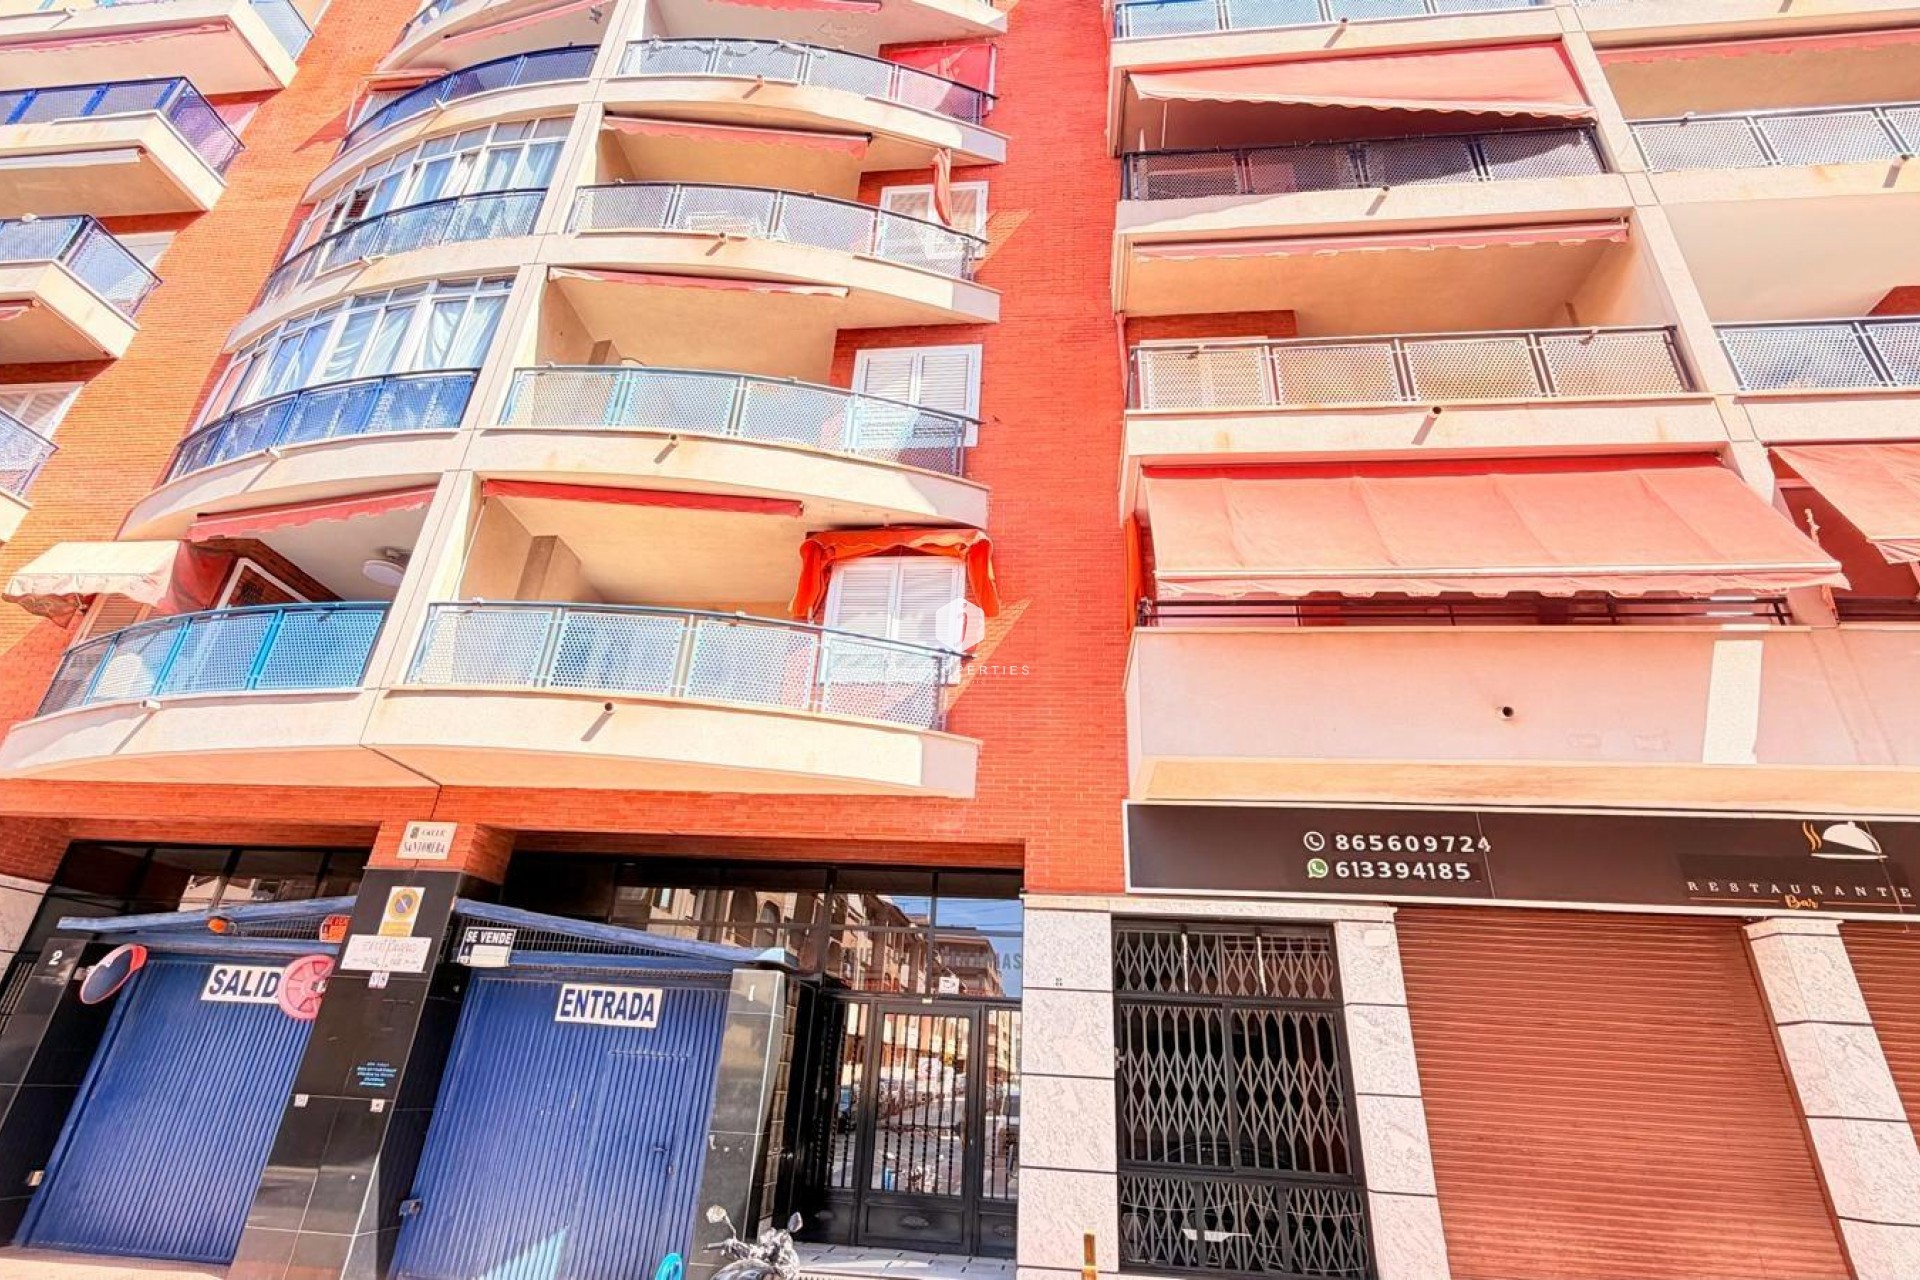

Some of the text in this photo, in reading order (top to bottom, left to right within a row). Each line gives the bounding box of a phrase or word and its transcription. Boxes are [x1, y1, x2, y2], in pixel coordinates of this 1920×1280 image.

[1335, 834, 1492, 853] 865609724
[1335, 861, 1471, 880] 613394185
[1686, 881, 1913, 898] RESTAURANTE
[1784, 893, 1819, 910] Bar
[466, 929, 514, 944] SE VENDE
[48, 949, 63, 965] 2
[208, 968, 282, 998] SALID
[559, 989, 655, 1021] ENTRADA
